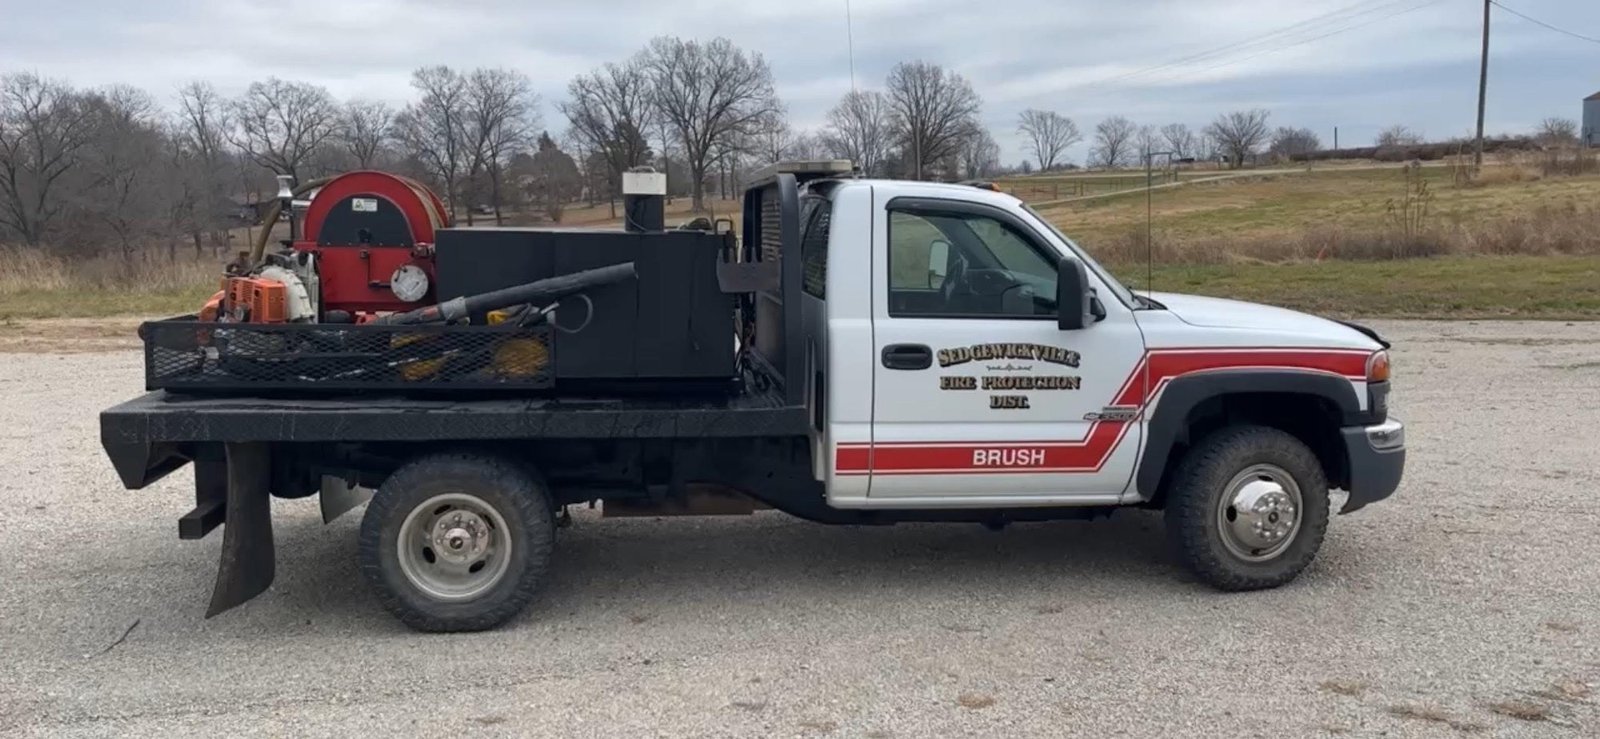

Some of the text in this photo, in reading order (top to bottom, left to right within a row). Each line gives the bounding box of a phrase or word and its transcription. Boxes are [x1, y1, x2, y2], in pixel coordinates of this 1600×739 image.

[937, 343, 1081, 368] SEDGEWICKVILLE
[940, 376, 1081, 390] FIRE PROTECTION
[989, 395, 1030, 409] DIST.
[972, 449, 1045, 465] BRUSH
